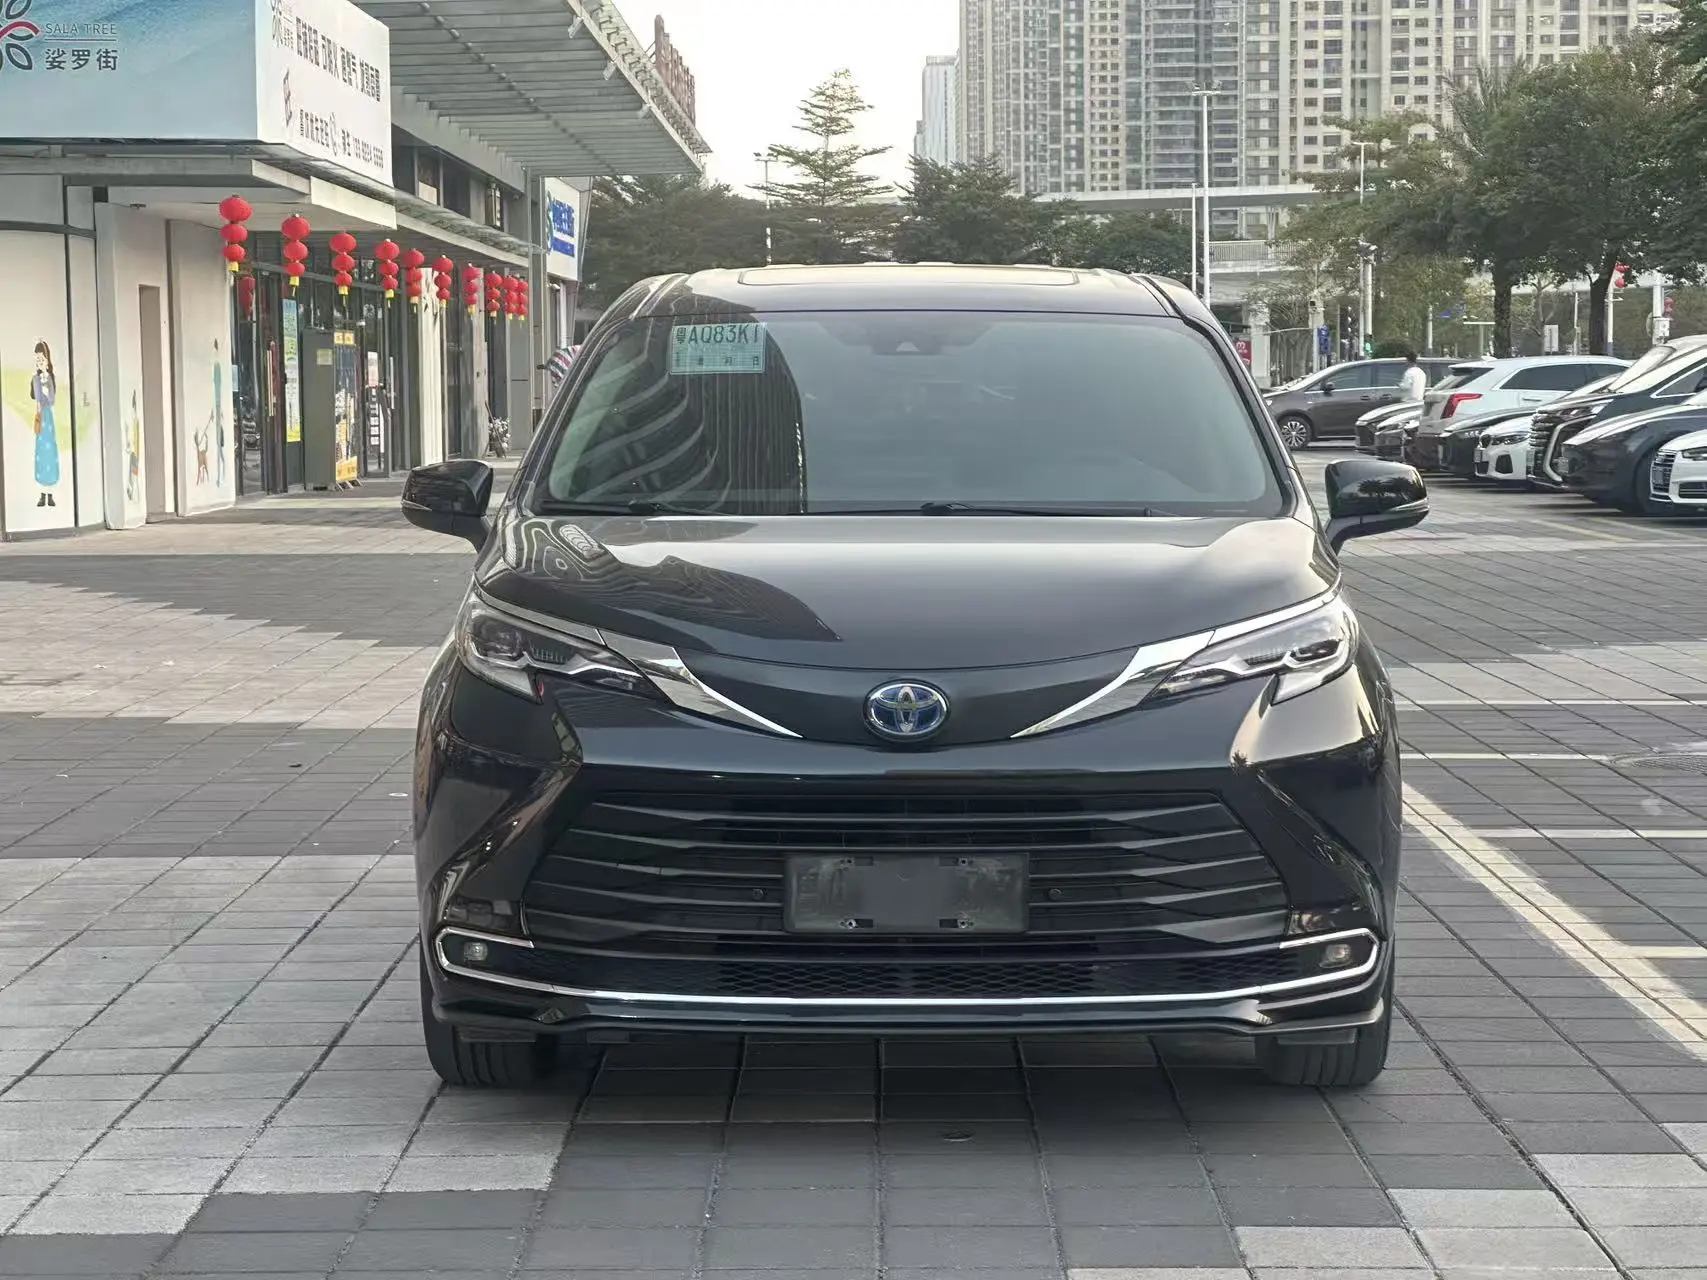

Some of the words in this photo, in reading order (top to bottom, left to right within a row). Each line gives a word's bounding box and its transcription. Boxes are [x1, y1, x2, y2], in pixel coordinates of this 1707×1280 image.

[45, 23, 79, 34] SALA
[83, 23, 117, 35] TREE
[45, 48, 118, 71] 娑罗街
